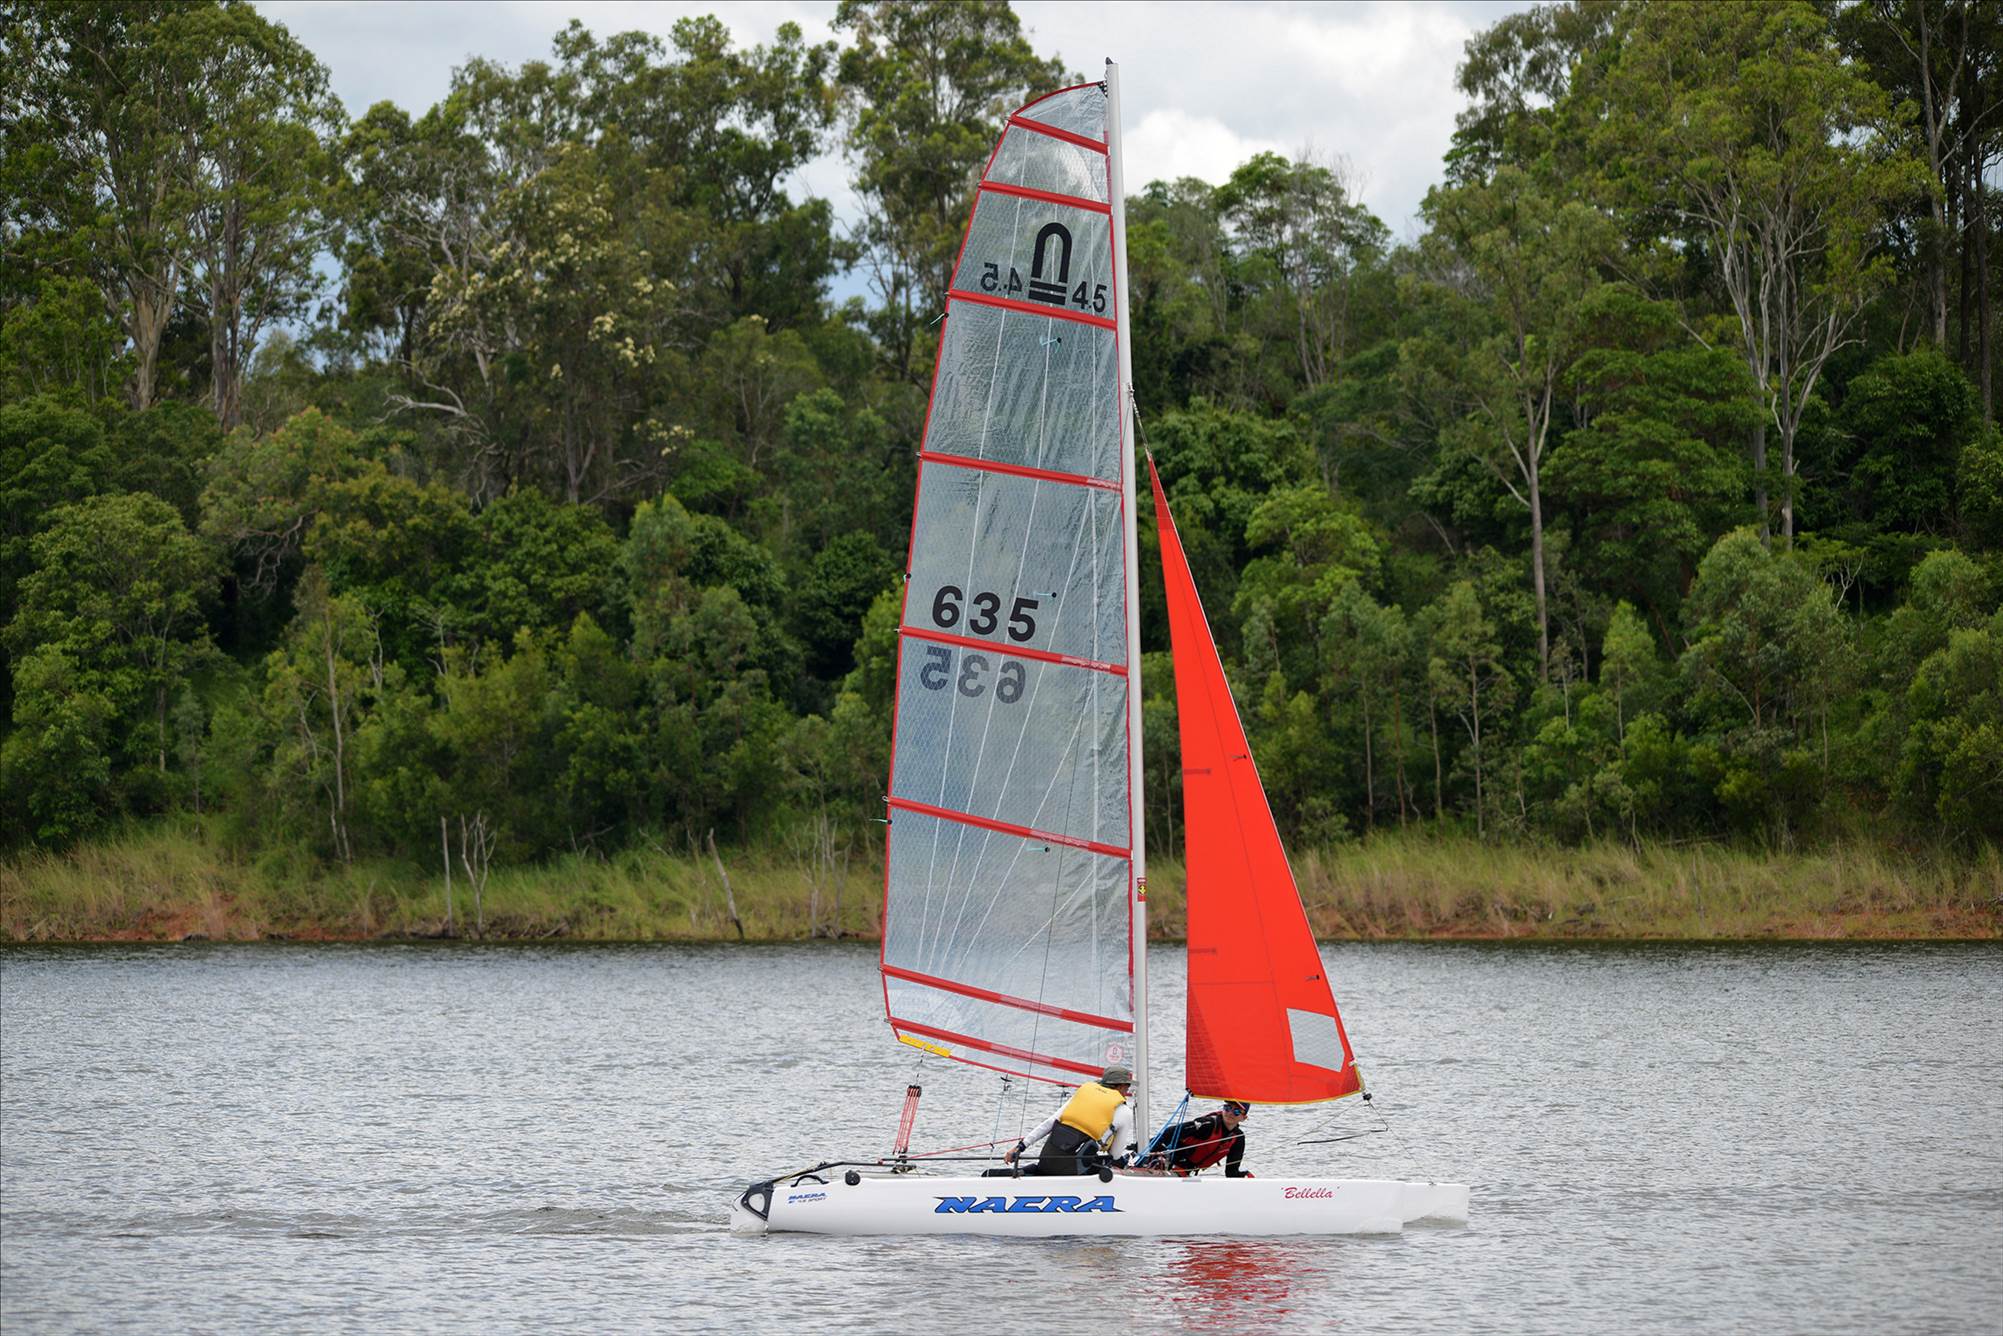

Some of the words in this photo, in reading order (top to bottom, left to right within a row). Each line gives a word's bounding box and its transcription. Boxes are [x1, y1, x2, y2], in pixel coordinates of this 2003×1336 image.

[1072, 281, 1107, 313] 4.5
[932, 585, 1039, 642] 635
[932, 1195, 1126, 1214] NACRA
[1281, 1186, 1334, 1199] Bellella
